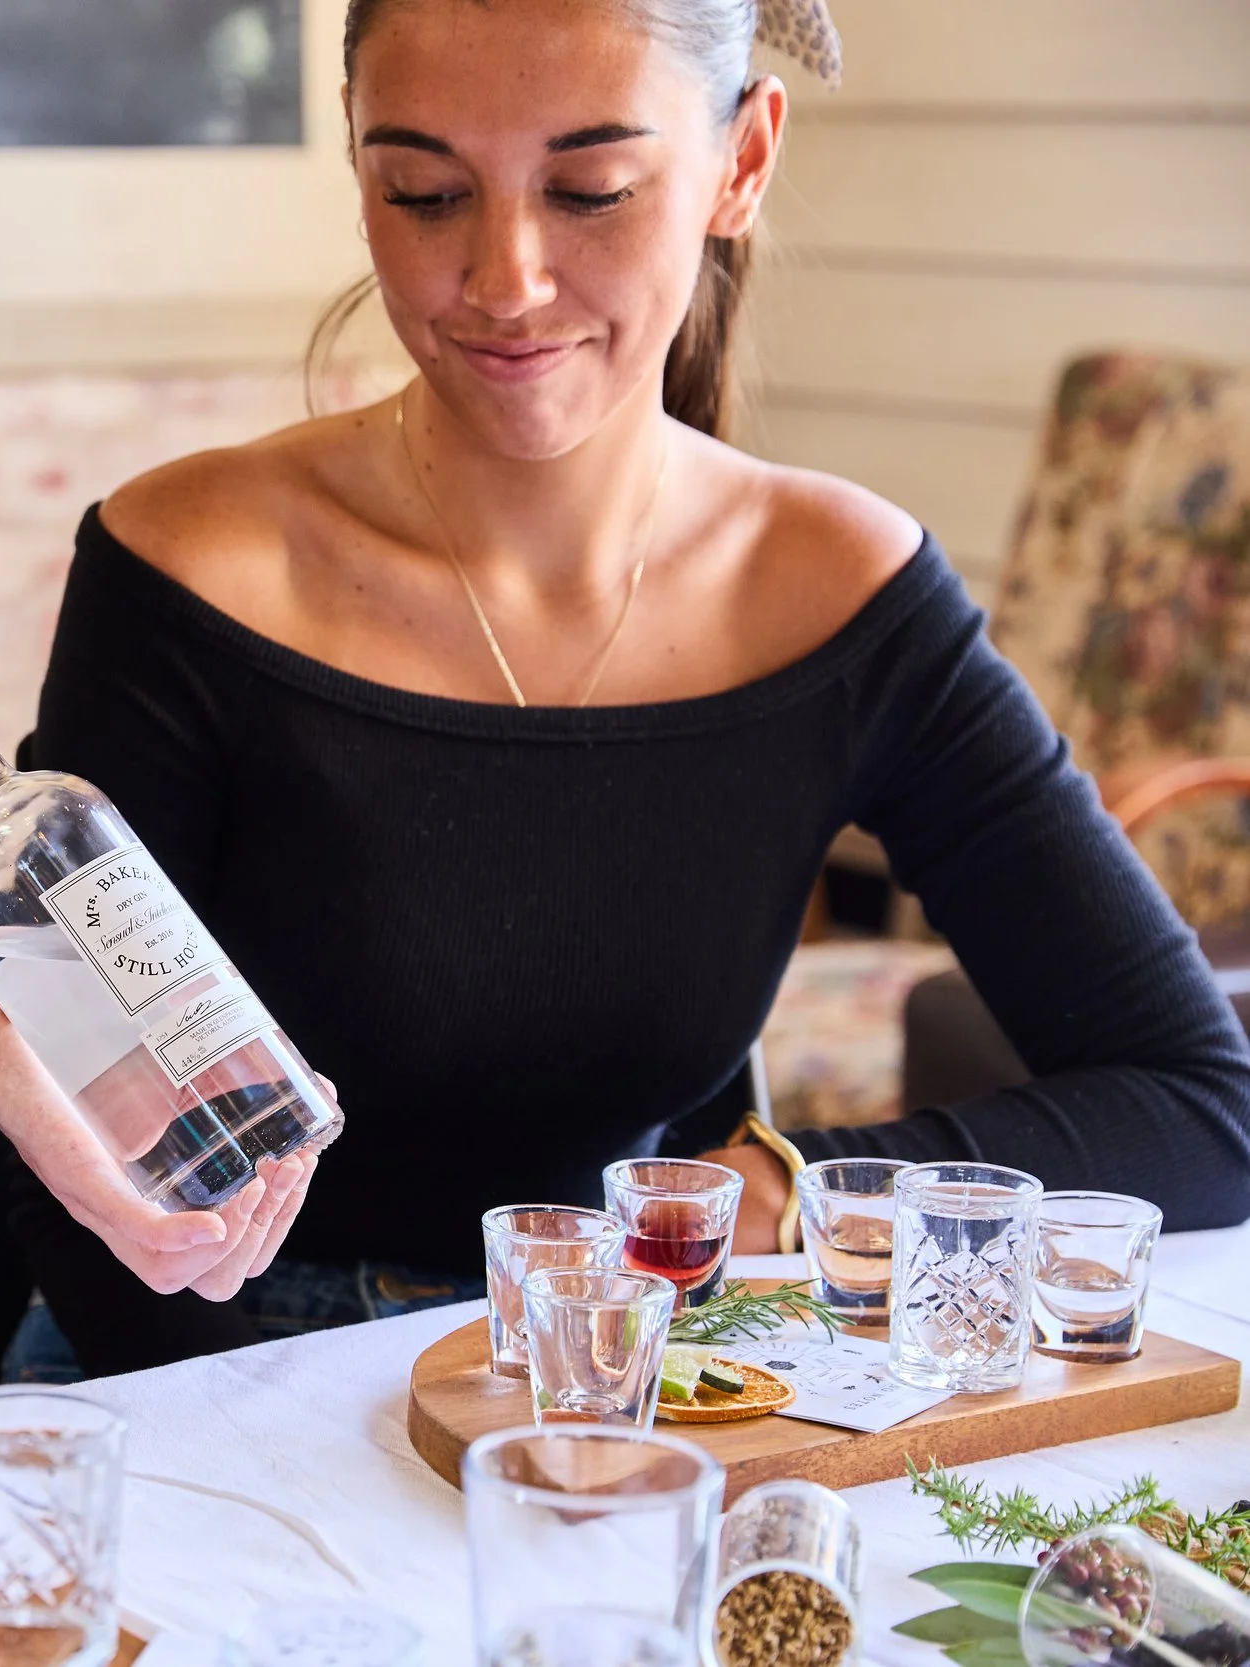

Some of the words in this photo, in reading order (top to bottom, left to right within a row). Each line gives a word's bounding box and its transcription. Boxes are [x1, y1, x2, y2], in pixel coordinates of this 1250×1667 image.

[86, 894, 101, 929] Mrs.
[116, 897, 133, 912] DRY
[133, 890, 148, 902] GIN
[134, 917, 148, 930] &
[157, 928, 174, 942] 2016
[113, 954, 172, 976] STILL
